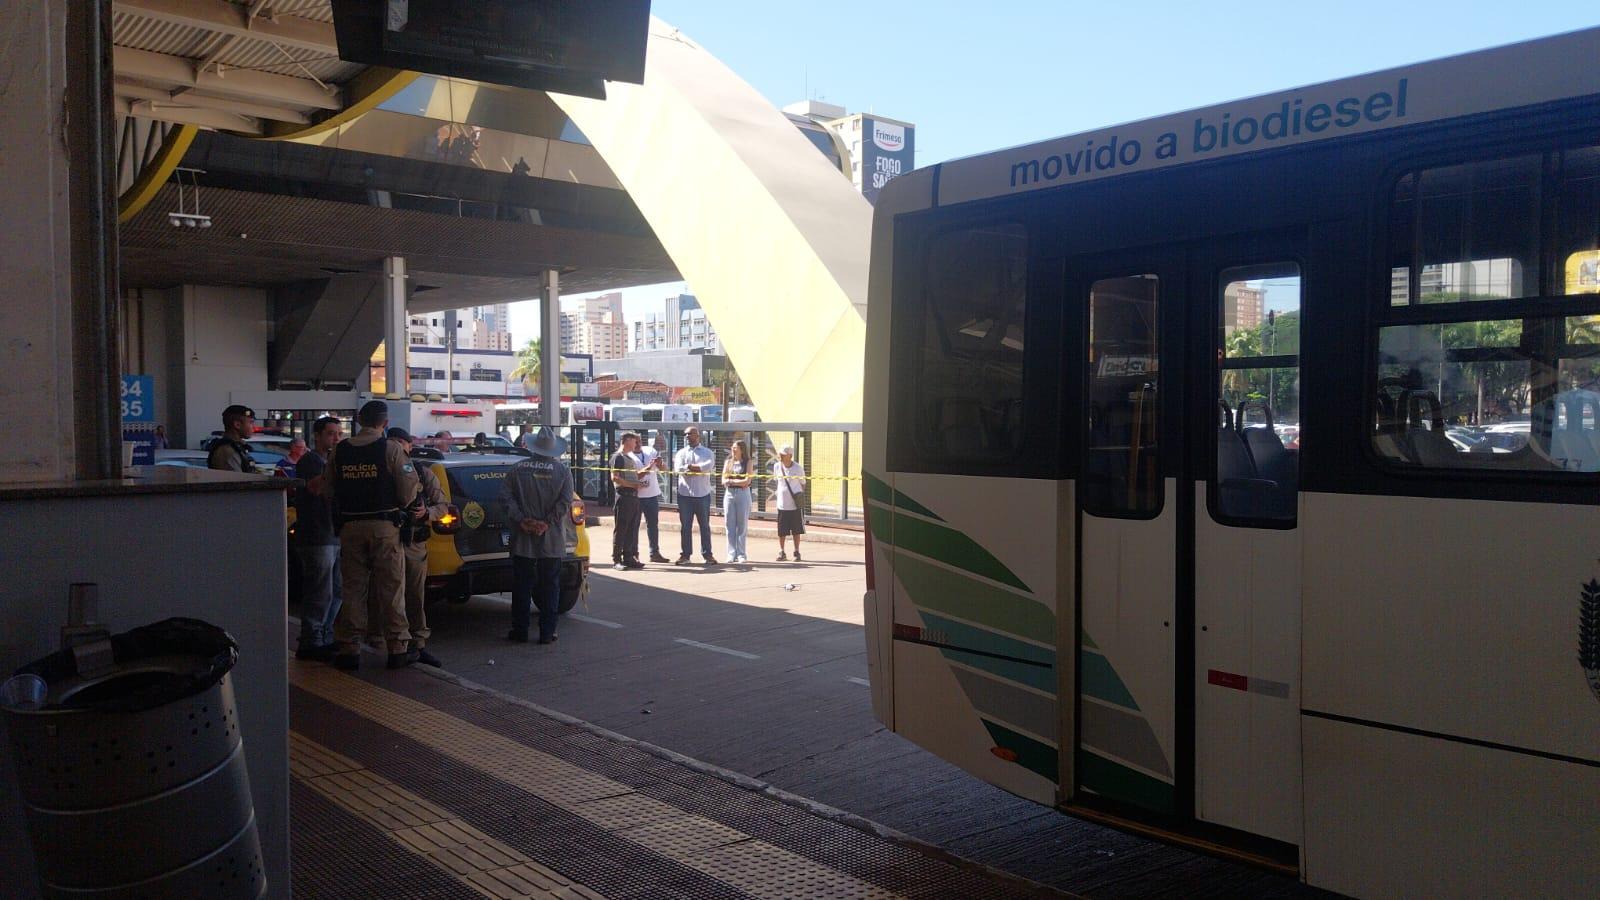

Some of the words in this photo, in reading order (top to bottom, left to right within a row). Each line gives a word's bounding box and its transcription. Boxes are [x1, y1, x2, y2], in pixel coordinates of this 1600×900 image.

[876, 129, 902, 144] Frimesa
[1010, 135, 1140, 187] movido
[1155, 131, 1177, 160] a
[1193, 79, 1408, 153] biodiesel
[876, 156, 901, 174] FOGO
[342, 463, 377, 472] POLÍCIA
[517, 461, 554, 471] POLÍCIA
[342, 471, 378, 480] MILITAR
